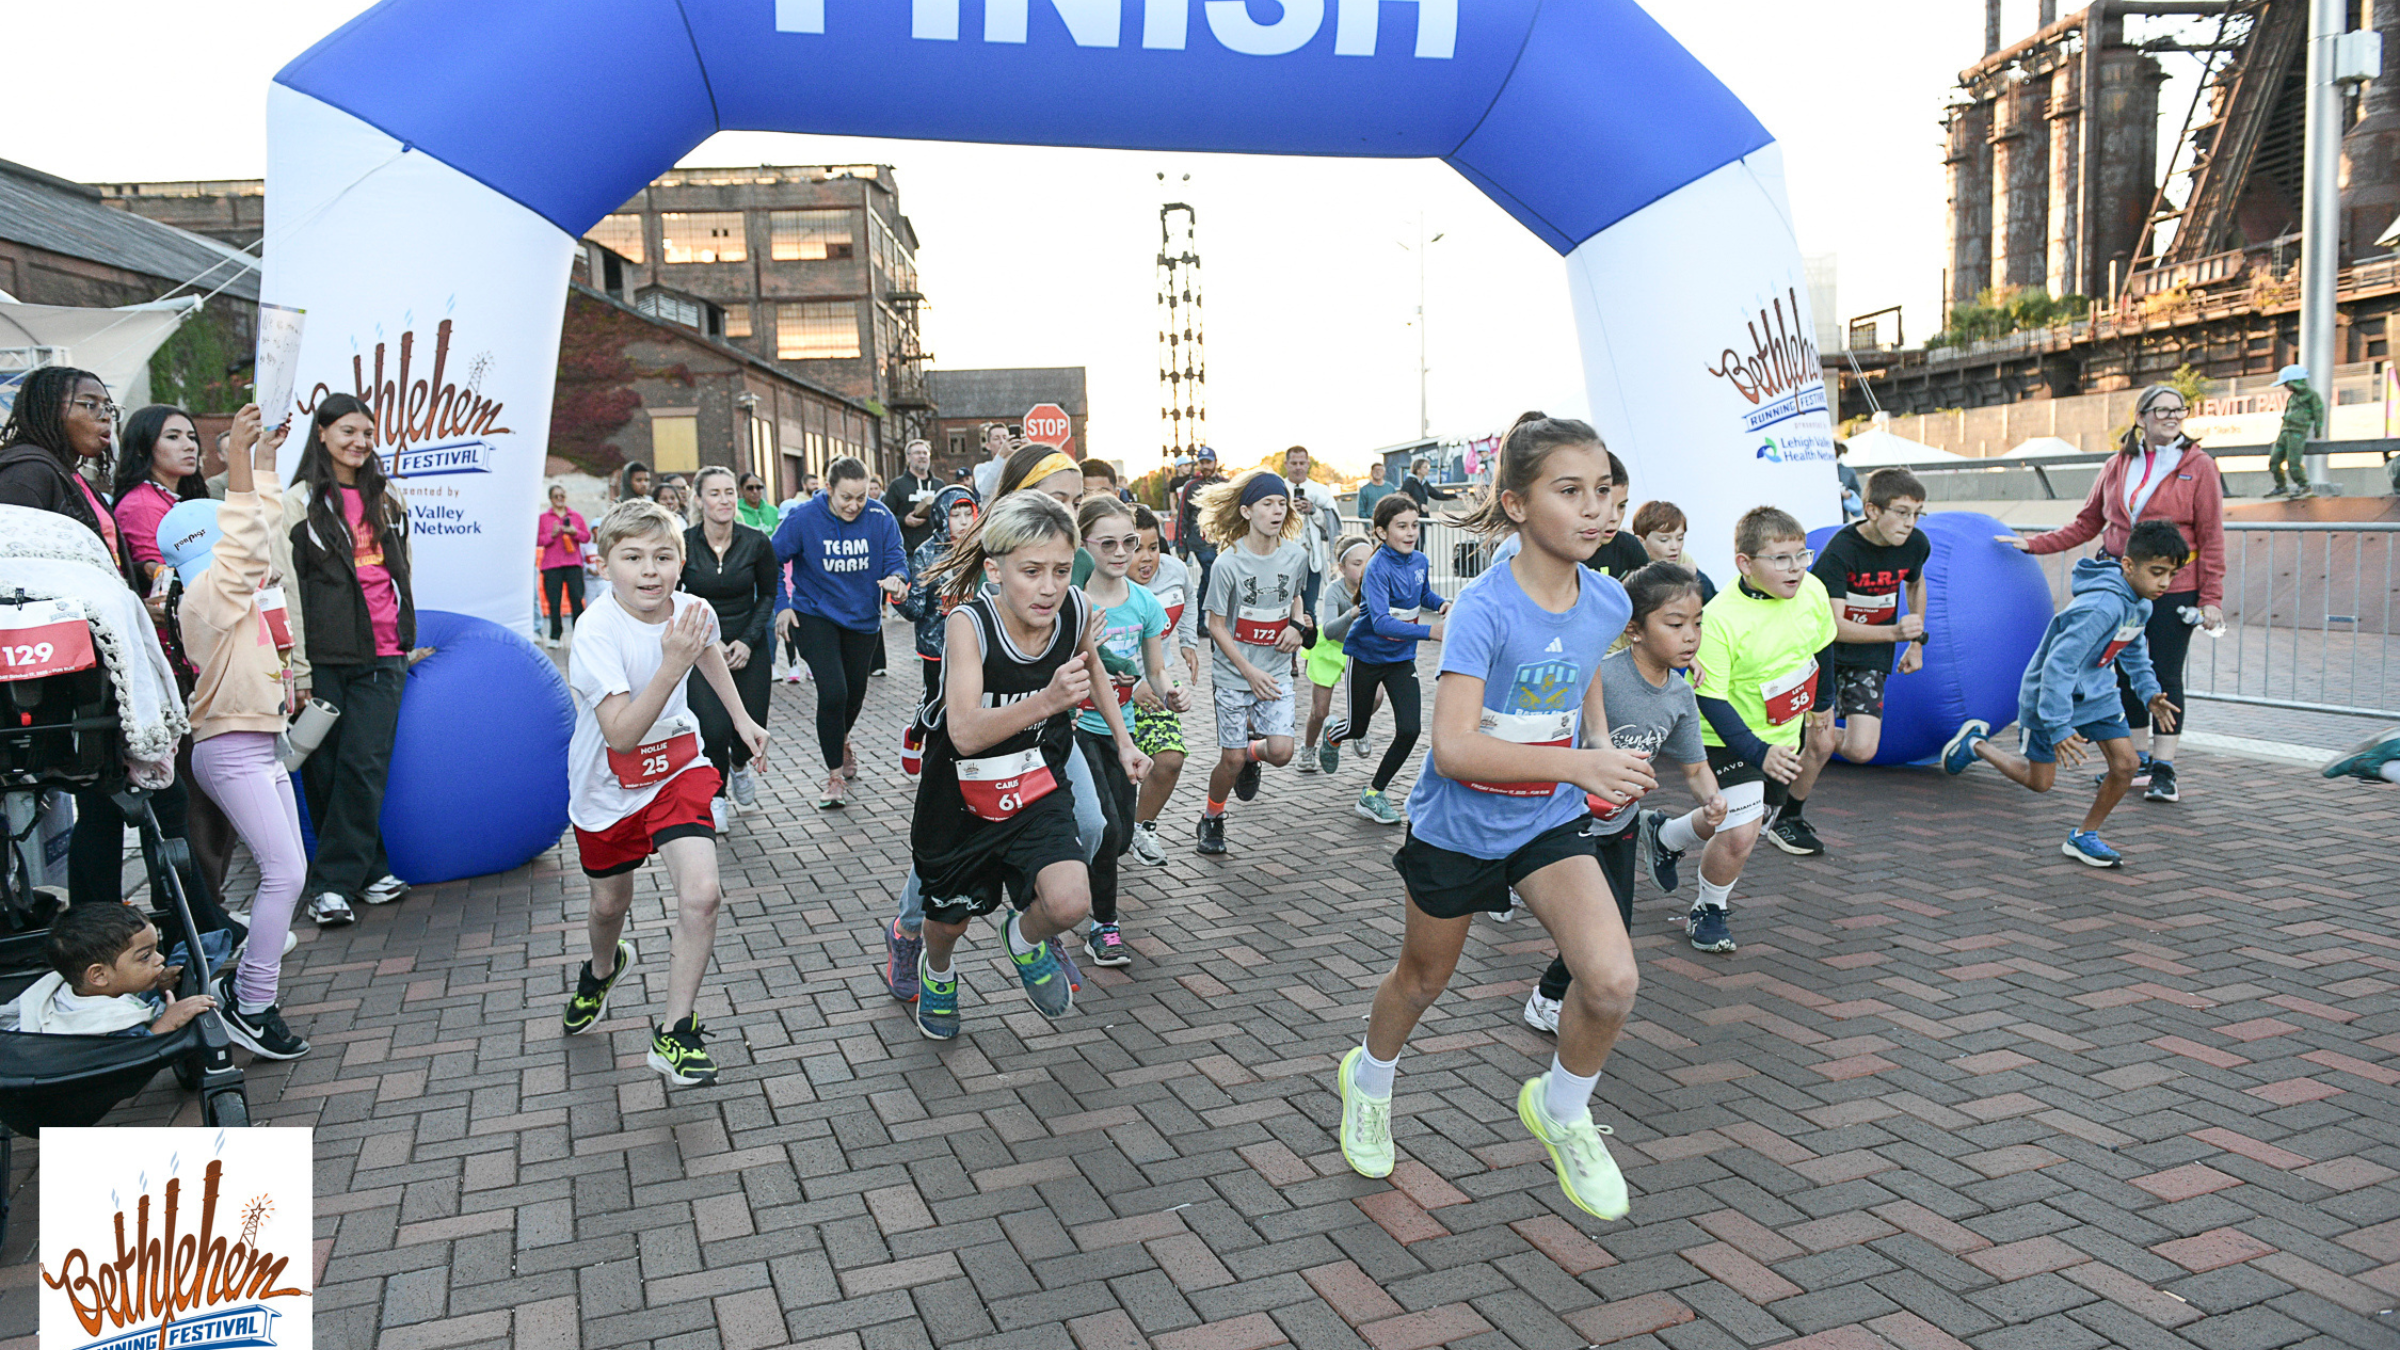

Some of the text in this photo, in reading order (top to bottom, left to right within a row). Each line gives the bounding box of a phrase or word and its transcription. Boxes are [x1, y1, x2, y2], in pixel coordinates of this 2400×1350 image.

[2193, 395, 2253, 417] LEVITT
[1750, 401, 1796, 427] RUNNING
[1027, 418, 1067, 437] STOP
[1780, 437, 1815, 450] Lehigh
[402, 448, 479, 470] FESTIVAL
[1784, 449, 1816, 462] Health
[447, 486, 460, 498] by
[414, 505, 464, 519] Valley
[414, 521, 482, 534] Network
[822, 538, 869, 556] TEAM
[822, 556, 870, 573] VARK
[1847, 606, 1879, 614] JONATHAN
[1852, 612, 1869, 625] 16
[1253, 628, 1276, 640] 172
[2, 641, 54, 667] 129
[1791, 684, 1806, 696] LEVI
[1790, 691, 1810, 712] 38
[640, 741, 669, 756] NOLLIE
[642, 753, 670, 777] 25
[994, 778, 1020, 791] CAIUS
[998, 792, 1024, 812] 61
